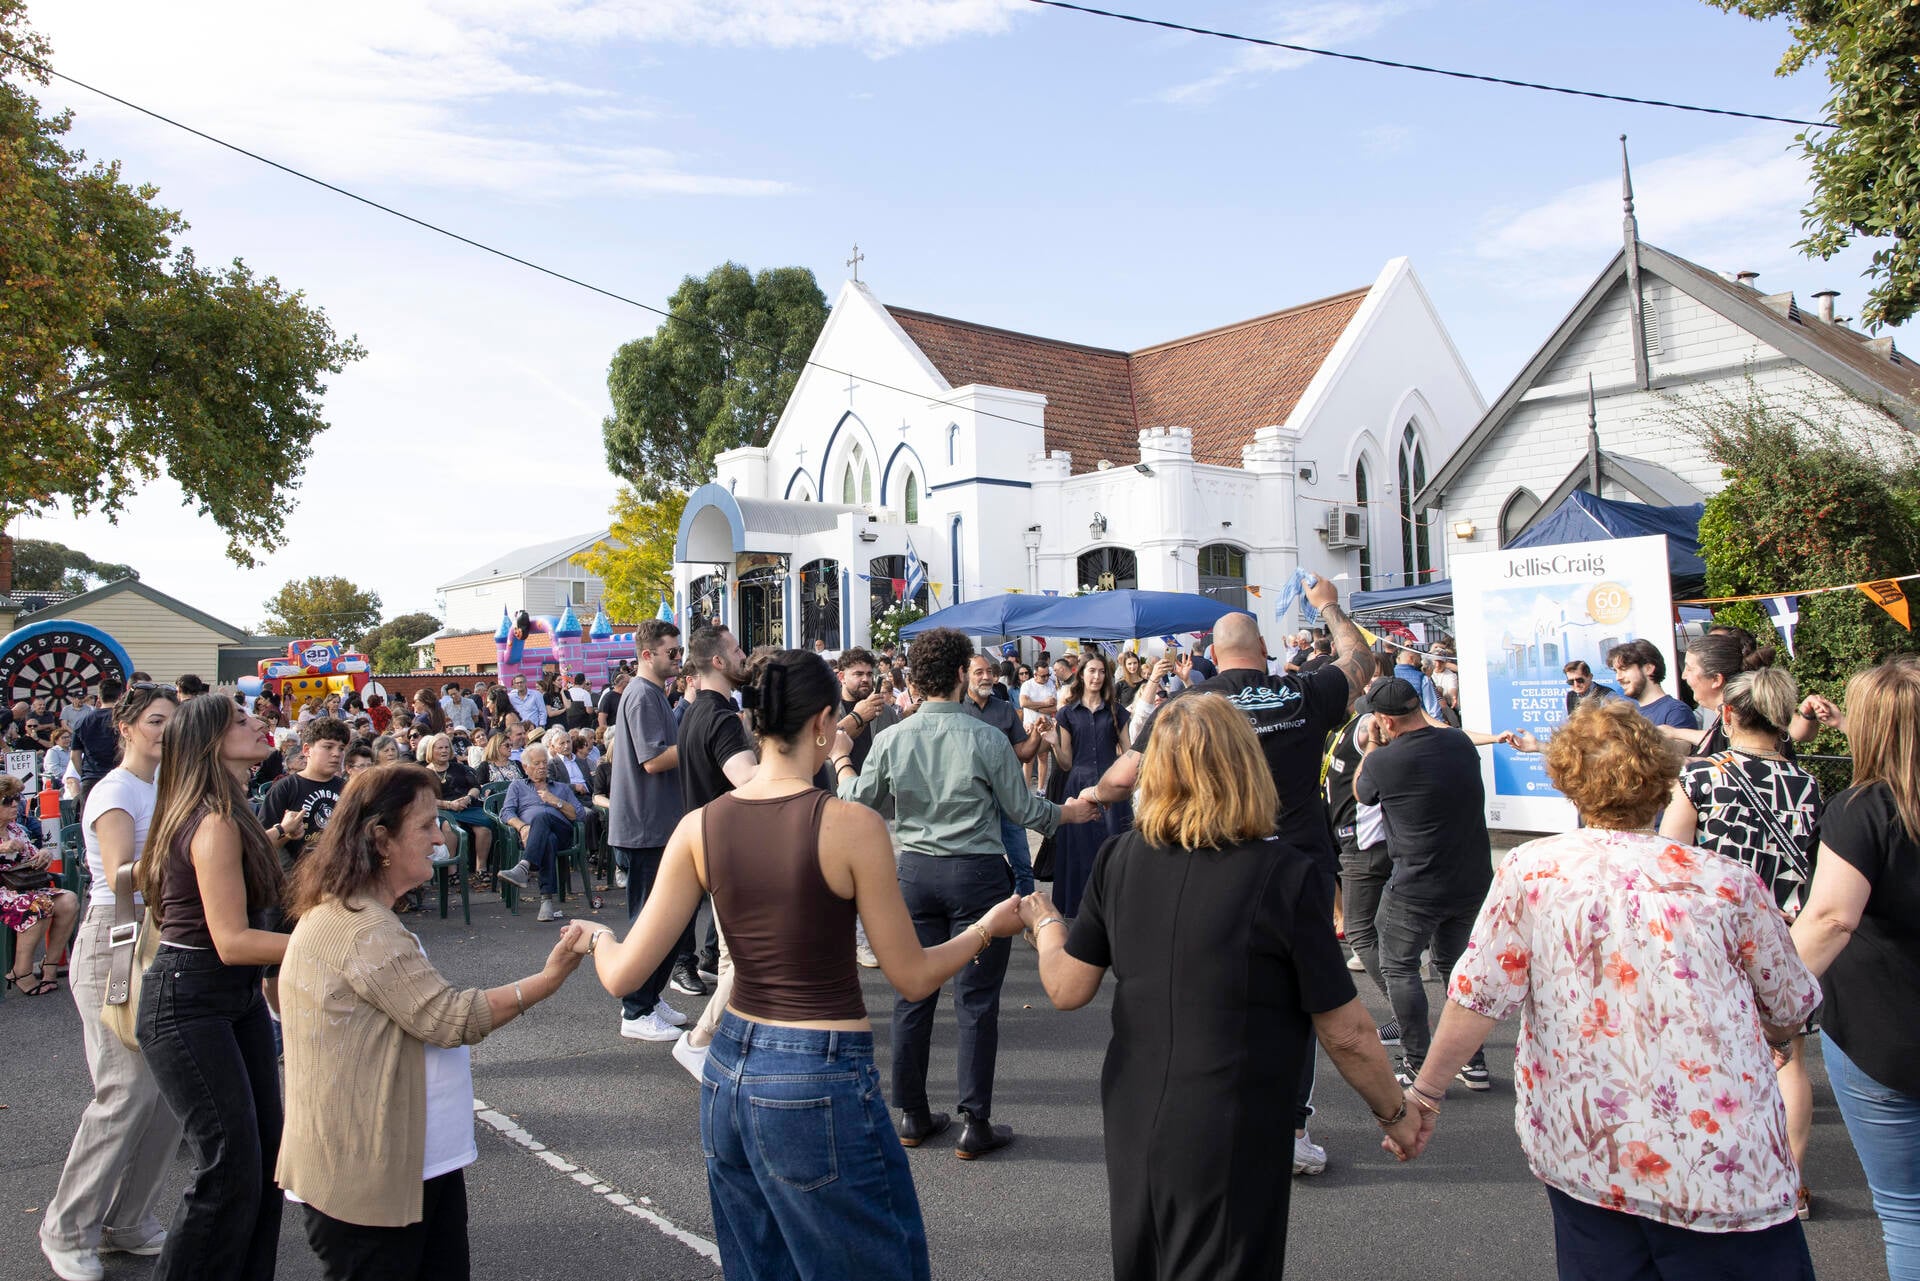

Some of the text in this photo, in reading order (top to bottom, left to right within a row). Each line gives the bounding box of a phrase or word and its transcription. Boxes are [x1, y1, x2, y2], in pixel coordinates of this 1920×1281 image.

[1595, 591, 1621, 609] 60
[39, 638, 47, 647] 5
[54, 635, 69, 644] 20
[17, 644, 33, 656] 12
[89, 644, 103, 656] 18
[306, 649, 328, 658] 3D
[6, 657, 15, 665] 9
[110, 668, 121, 680] 13
[1512, 699, 1558, 709] FEAST
[1522, 711, 1540, 722] ST
[11, 754, 31, 762] KEEP
[12, 762, 30, 771] LEFT
[302, 789, 341, 818] COLLINGW
